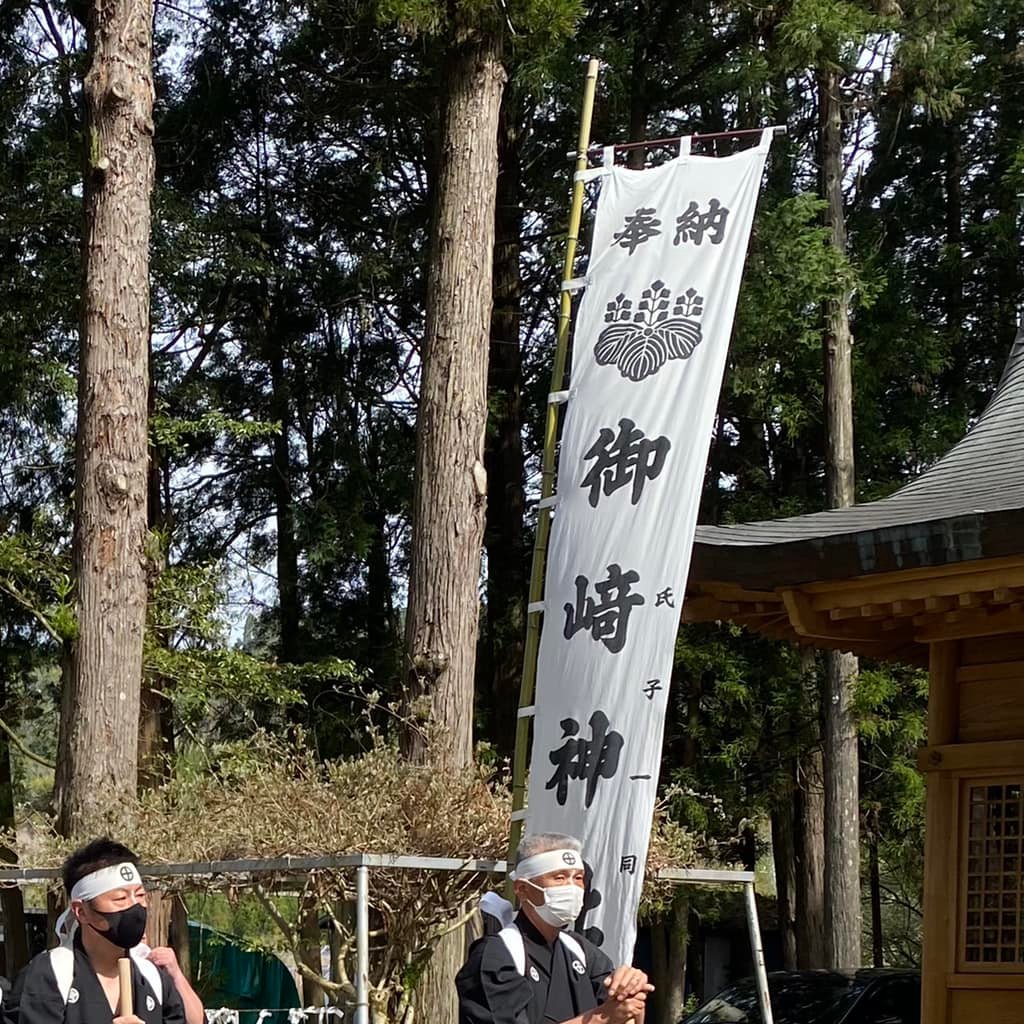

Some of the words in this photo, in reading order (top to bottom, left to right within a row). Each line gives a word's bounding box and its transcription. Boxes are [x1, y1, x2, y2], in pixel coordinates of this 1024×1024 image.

[610, 198, 730, 256] 奉納
[618, 586, 676, 876] 氏子一同
